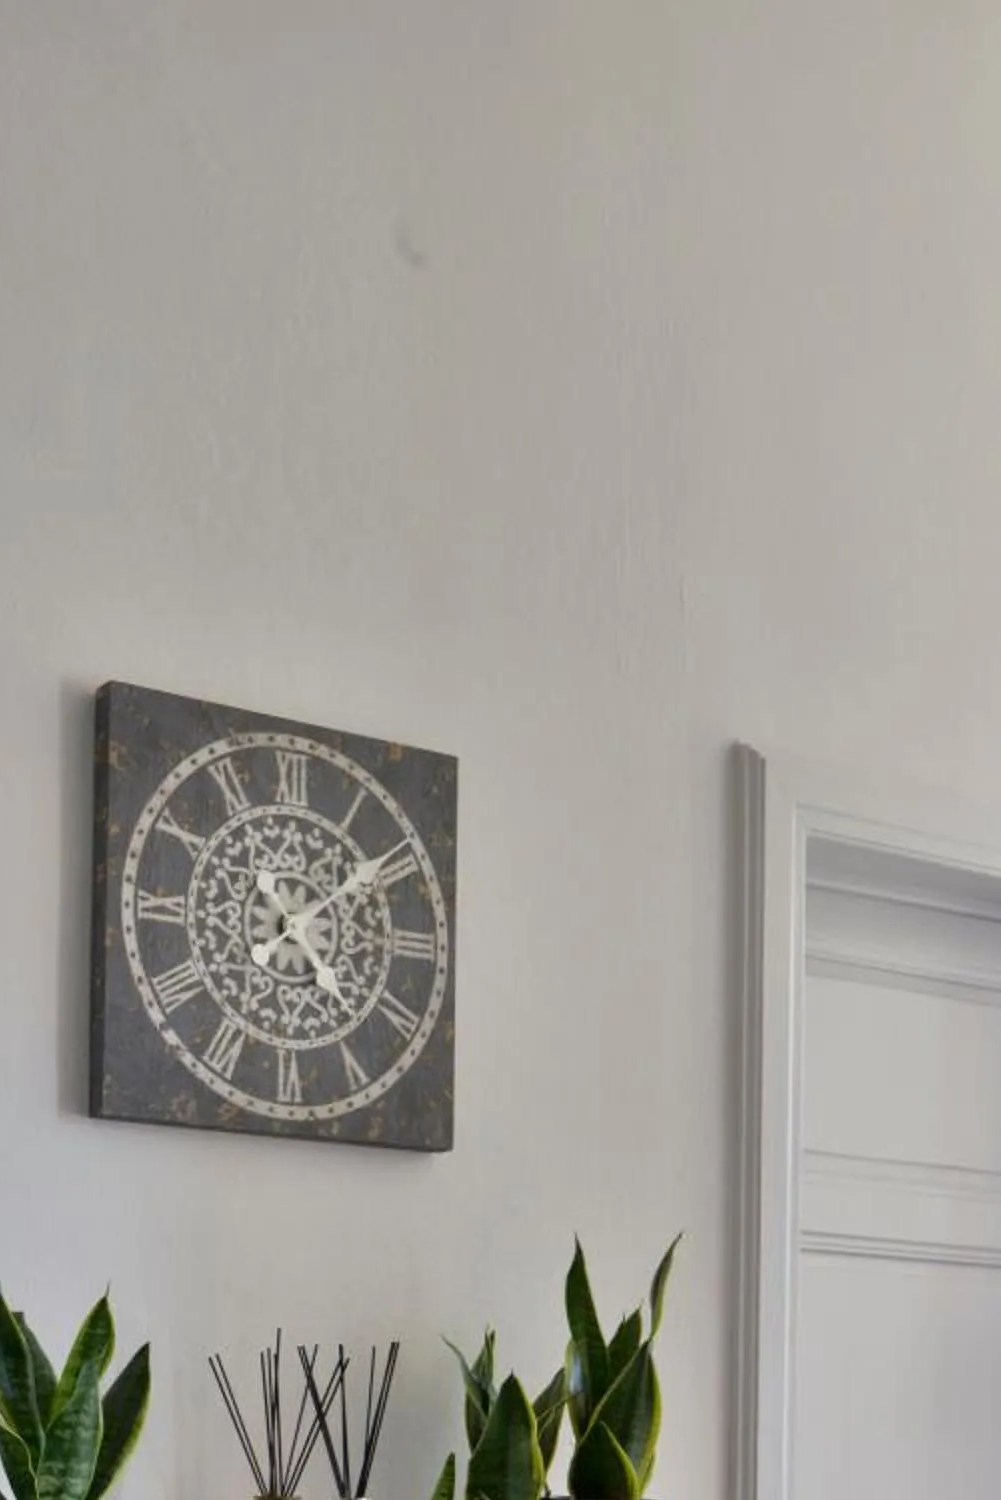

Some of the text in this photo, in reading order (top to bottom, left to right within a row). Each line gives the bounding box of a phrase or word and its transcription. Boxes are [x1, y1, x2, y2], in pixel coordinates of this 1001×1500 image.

[208, 756, 251, 816] XI
[276, 750, 308, 807] XII
[154, 806, 206, 859] X
[393, 928, 436, 963] III
